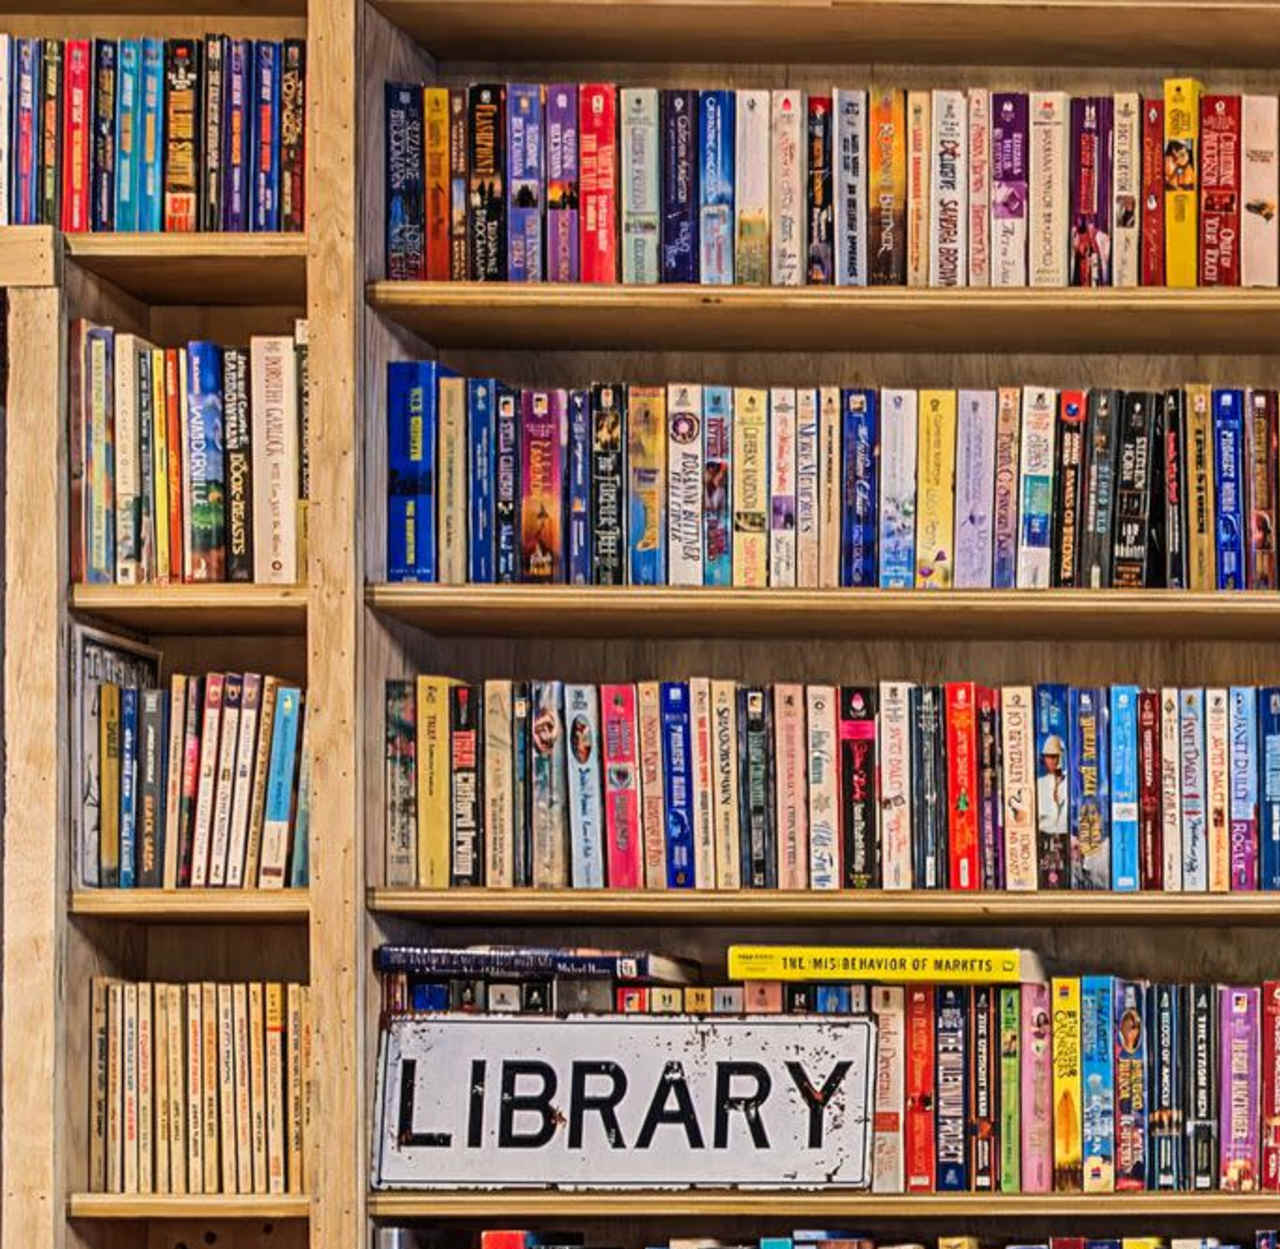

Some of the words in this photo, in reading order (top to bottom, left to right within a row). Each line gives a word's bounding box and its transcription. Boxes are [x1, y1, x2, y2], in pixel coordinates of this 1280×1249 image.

[912, 957, 927, 971] OF
[934, 958, 993, 973] MARKETS
[877, 1013, 895, 1044] Jude
[398, 1058, 853, 1149] LIBRARY
